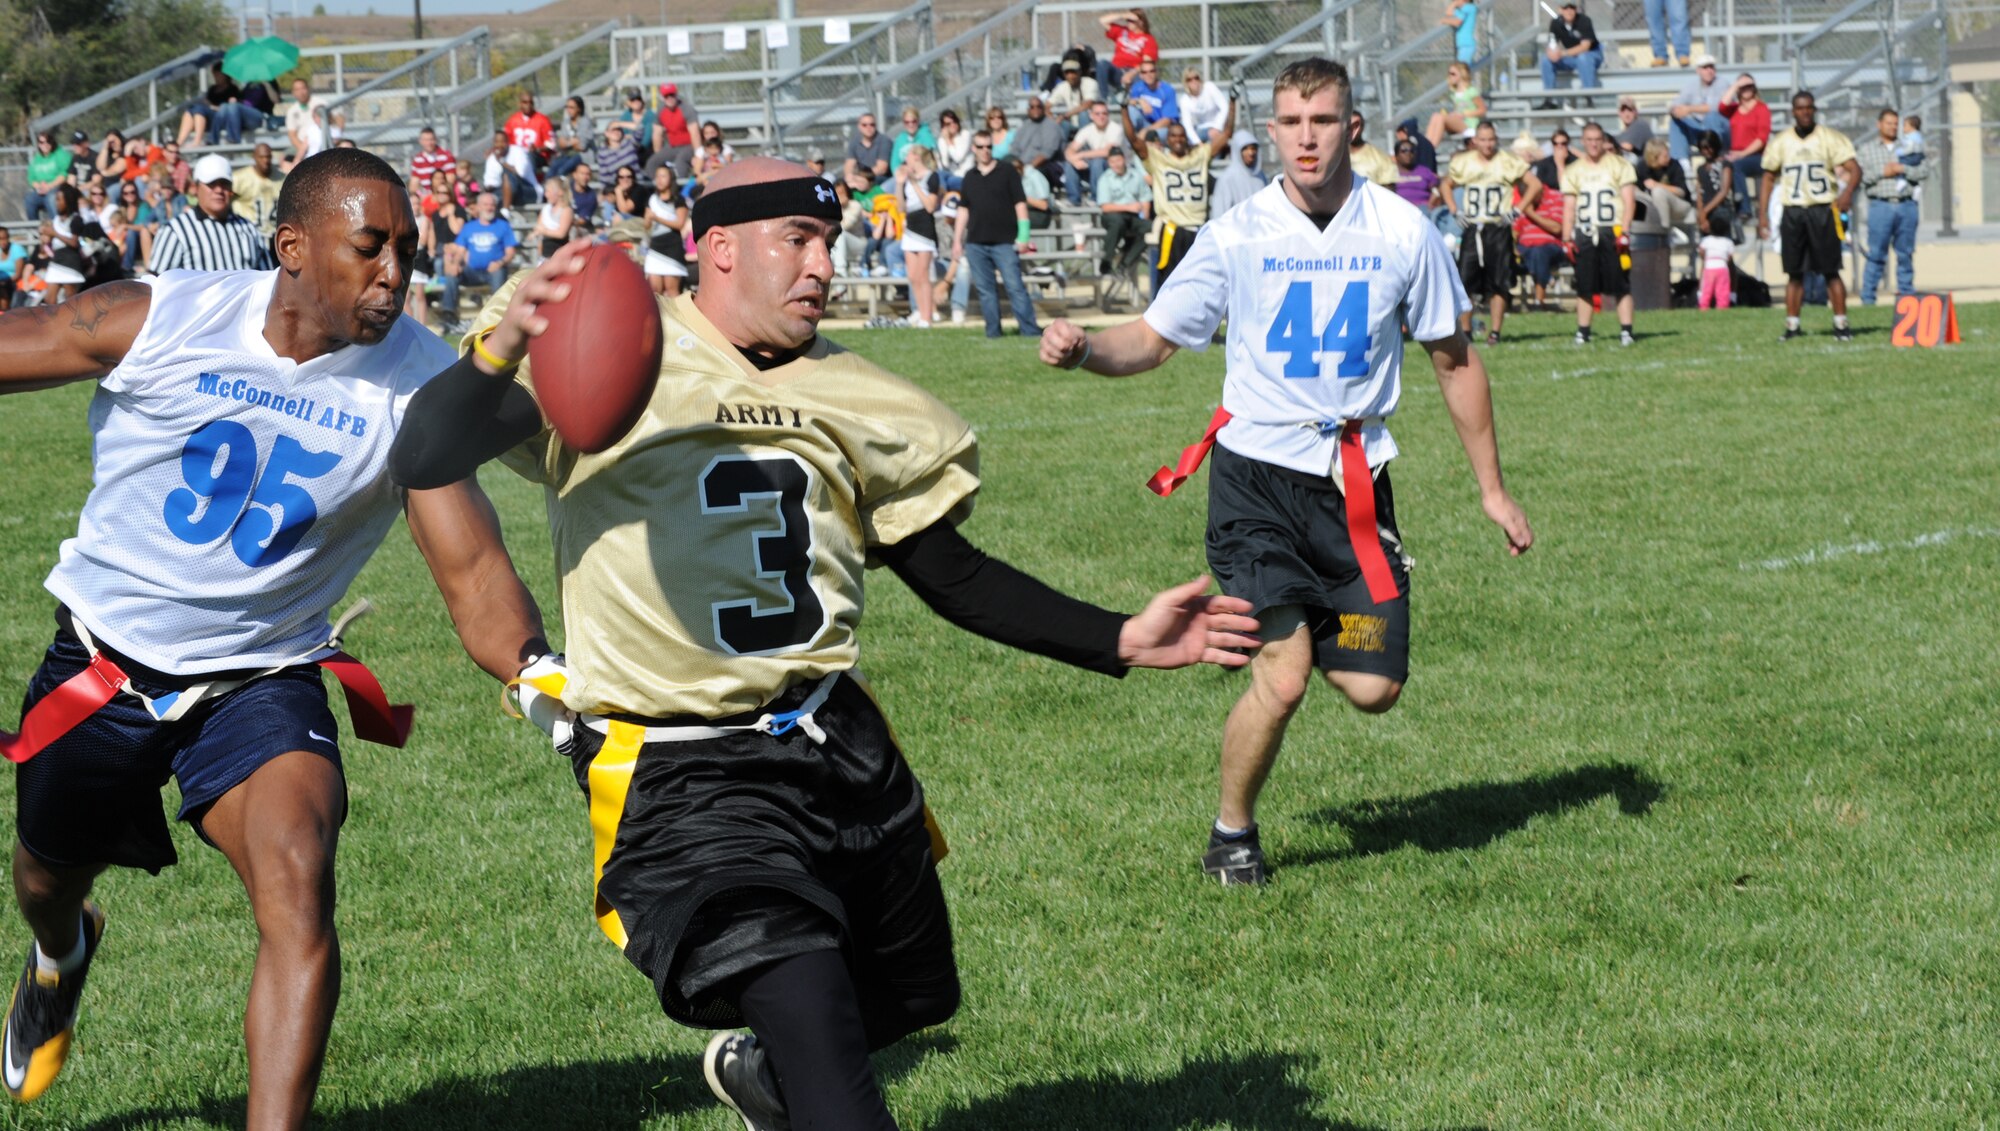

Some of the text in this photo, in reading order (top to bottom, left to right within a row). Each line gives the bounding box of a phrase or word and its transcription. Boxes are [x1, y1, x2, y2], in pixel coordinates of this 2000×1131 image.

[1165, 171, 1203, 201] 25
[1784, 163, 1828, 199] 75
[1578, 190, 1615, 223] 26
[1263, 256, 1382, 272] McConnell AFB
[1266, 281, 1372, 379] 44
[1891, 294, 1943, 347] 20
[195, 372, 367, 438] McConnell AFB
[714, 402, 803, 428] ARMY
[163, 419, 344, 569] 95
[698, 454, 830, 657] 3
